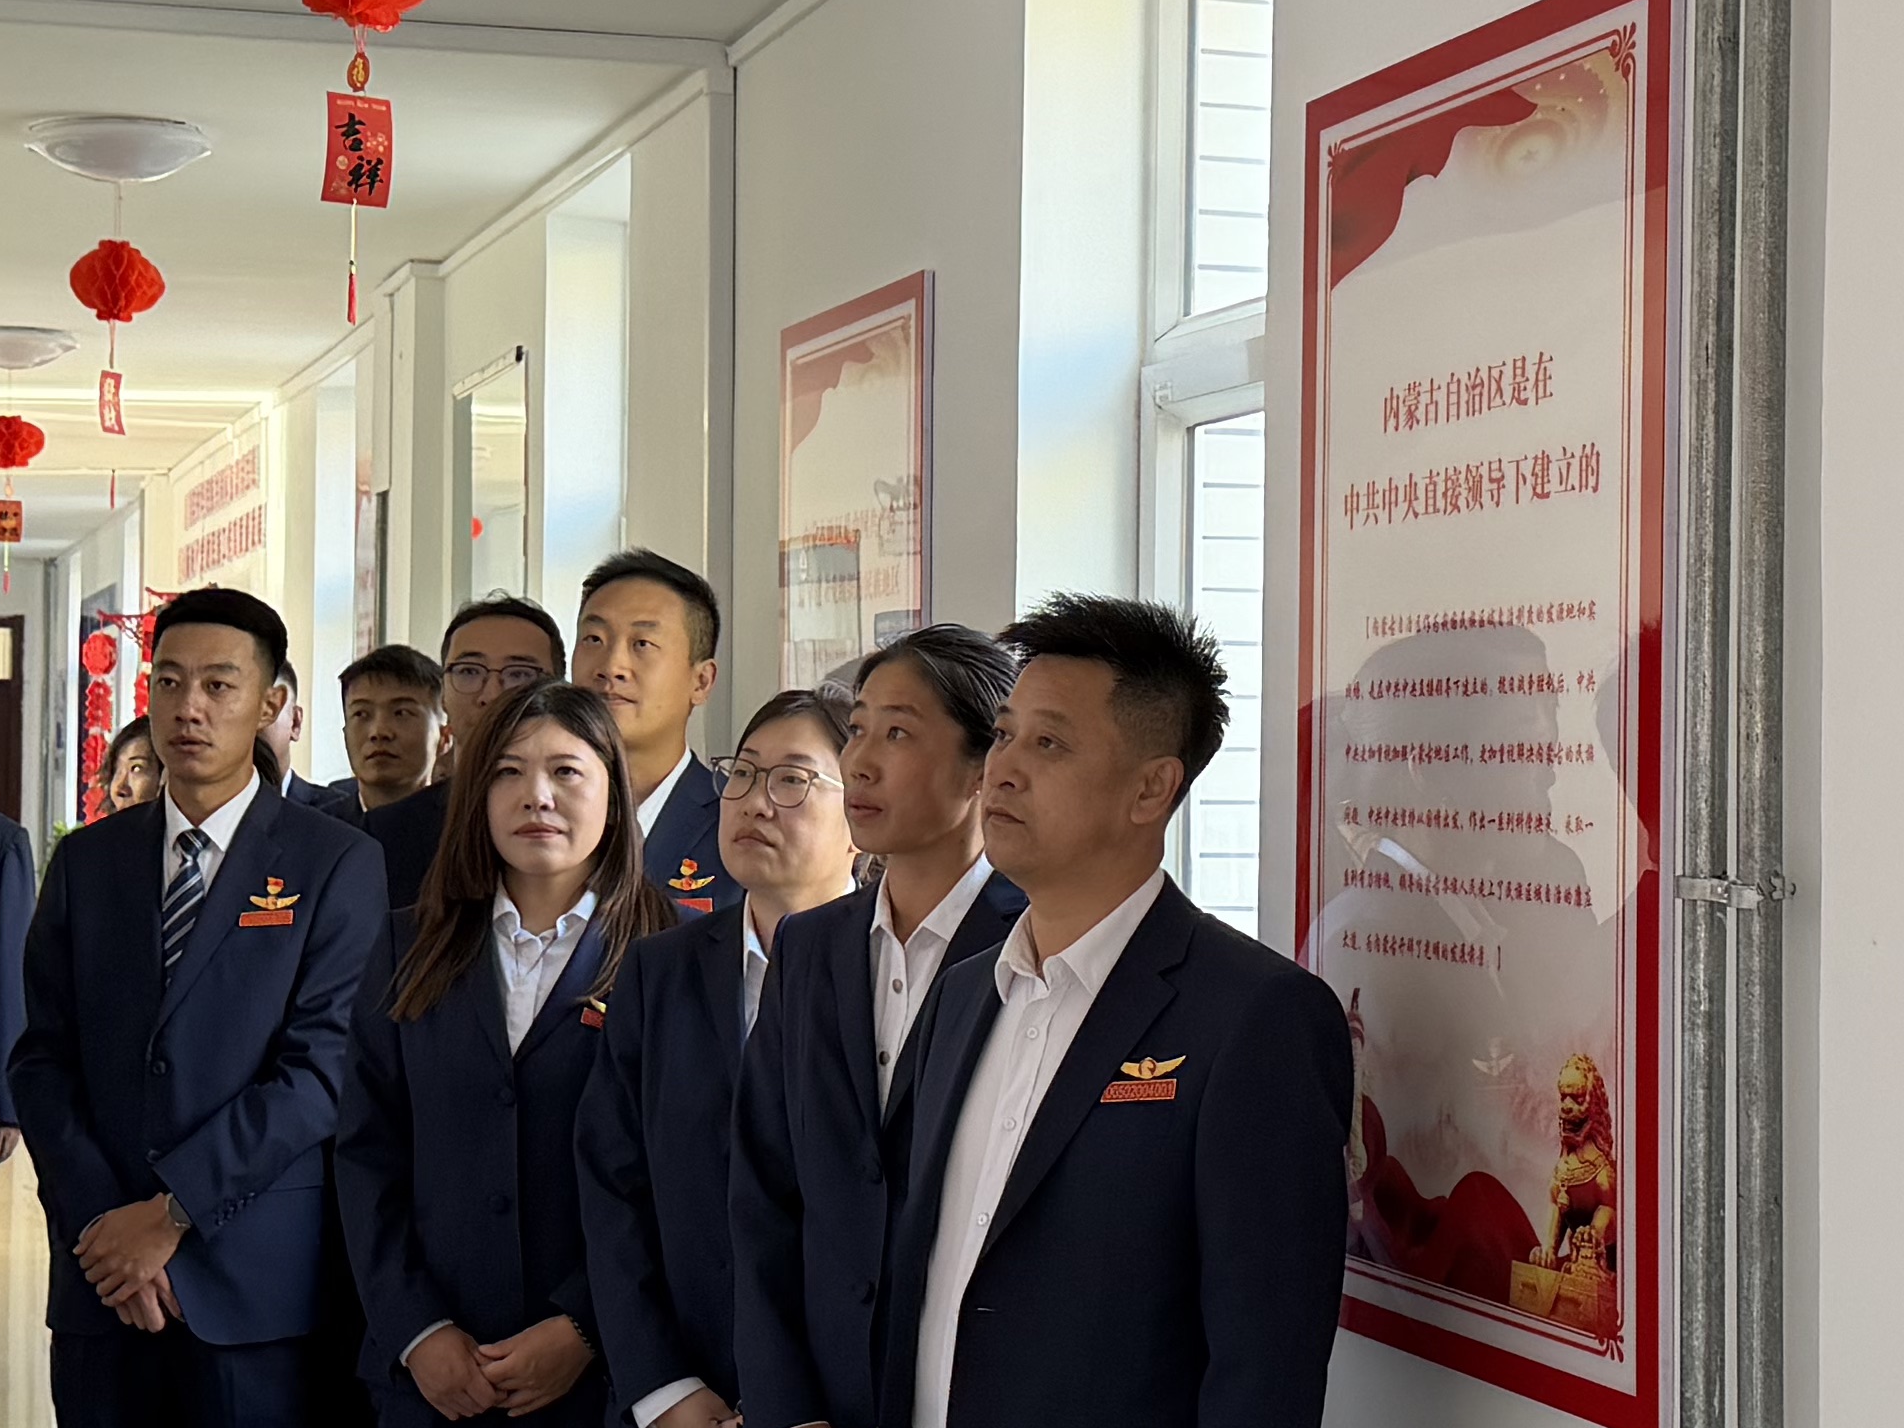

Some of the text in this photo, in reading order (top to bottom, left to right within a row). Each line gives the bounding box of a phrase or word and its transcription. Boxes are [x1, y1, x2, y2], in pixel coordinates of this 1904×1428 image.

[335, 112, 384, 196] 吉祥
[1383, 351, 1554, 433] 内蒙古自治区是在
[1344, 442, 1601, 531] 中共中央直接领导下建立的
